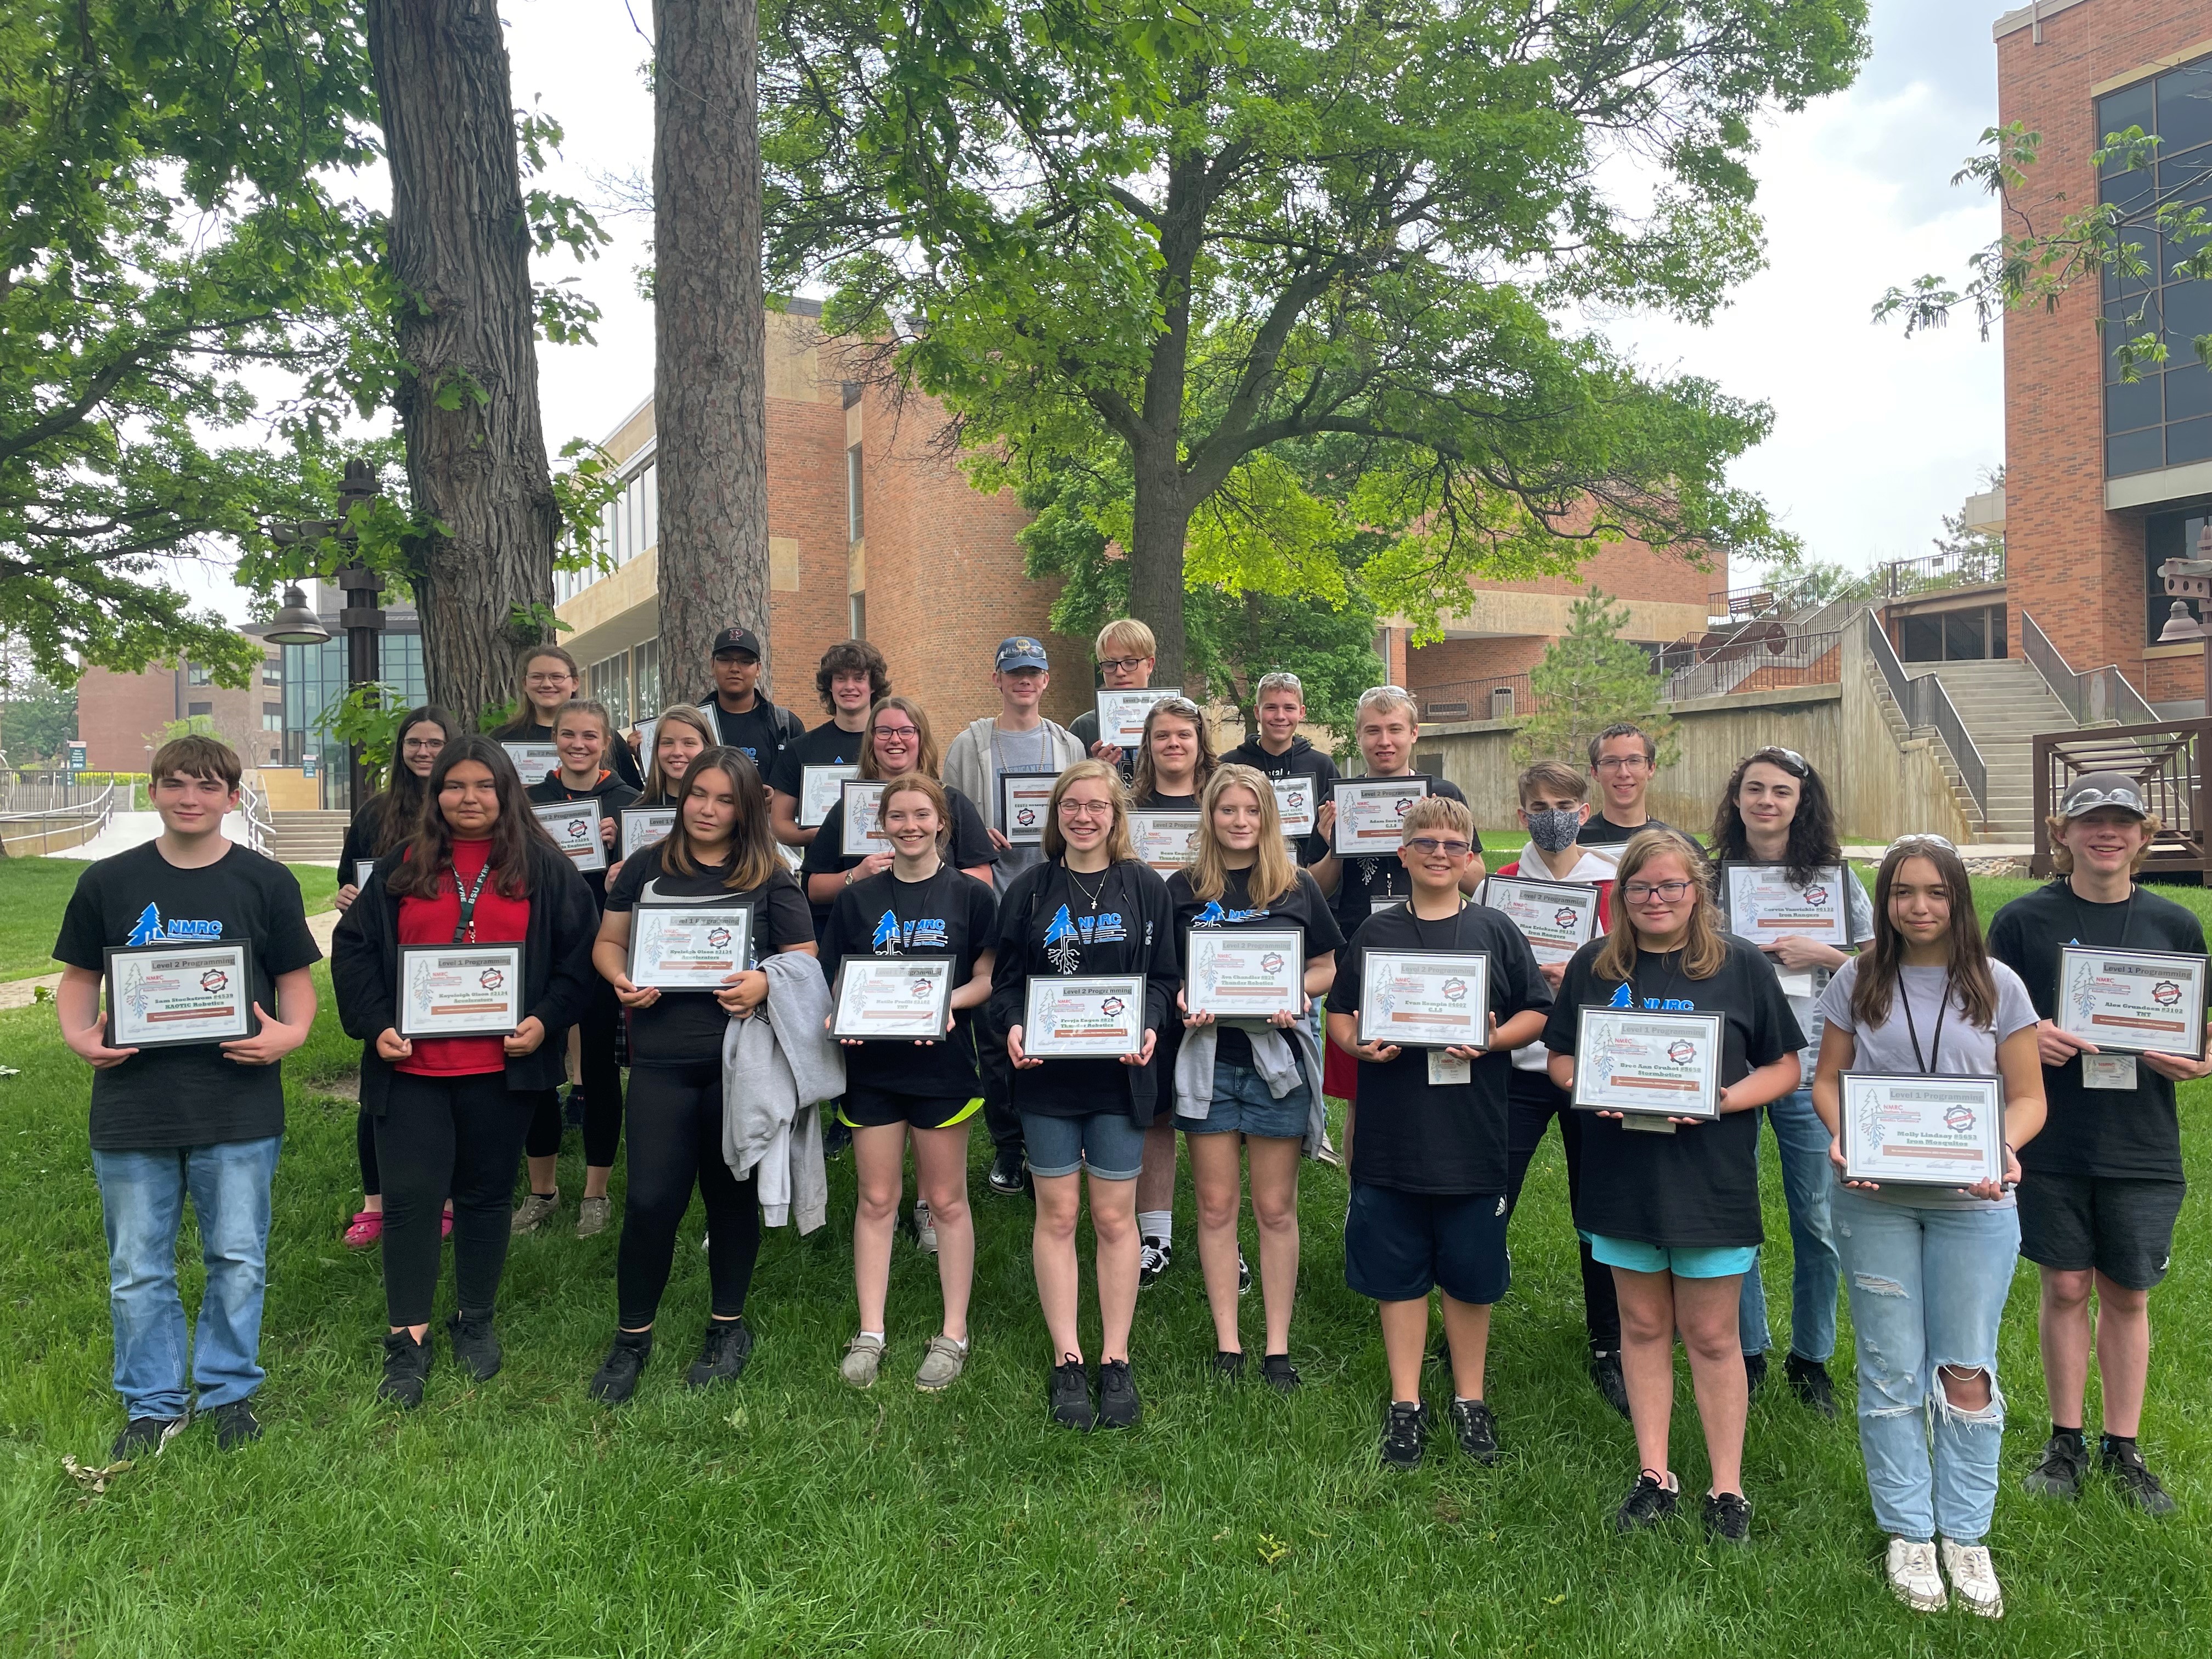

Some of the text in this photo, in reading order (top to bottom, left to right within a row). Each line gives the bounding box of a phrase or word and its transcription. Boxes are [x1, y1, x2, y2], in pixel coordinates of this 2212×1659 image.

[554, 811, 592, 819] Programming
[468, 887, 480, 904] BSU
[1544, 895, 1587, 907] Programming
[167, 919, 223, 935] NMRC
[182, 957, 235, 967] Programming
[465, 958, 511, 966] Programming
[1428, 967, 1476, 977] Programming
[2103, 965, 2125, 973] Level
[2135, 968, 2193, 979] Programming
[1087, 987, 1132, 995] Programming
[1622, 1025, 1643, 1033] Level
[1652, 1026, 1706, 1037] Programming
[1889, 1091, 1913, 1099] Level
[1923, 1092, 1985, 1103] Programming
